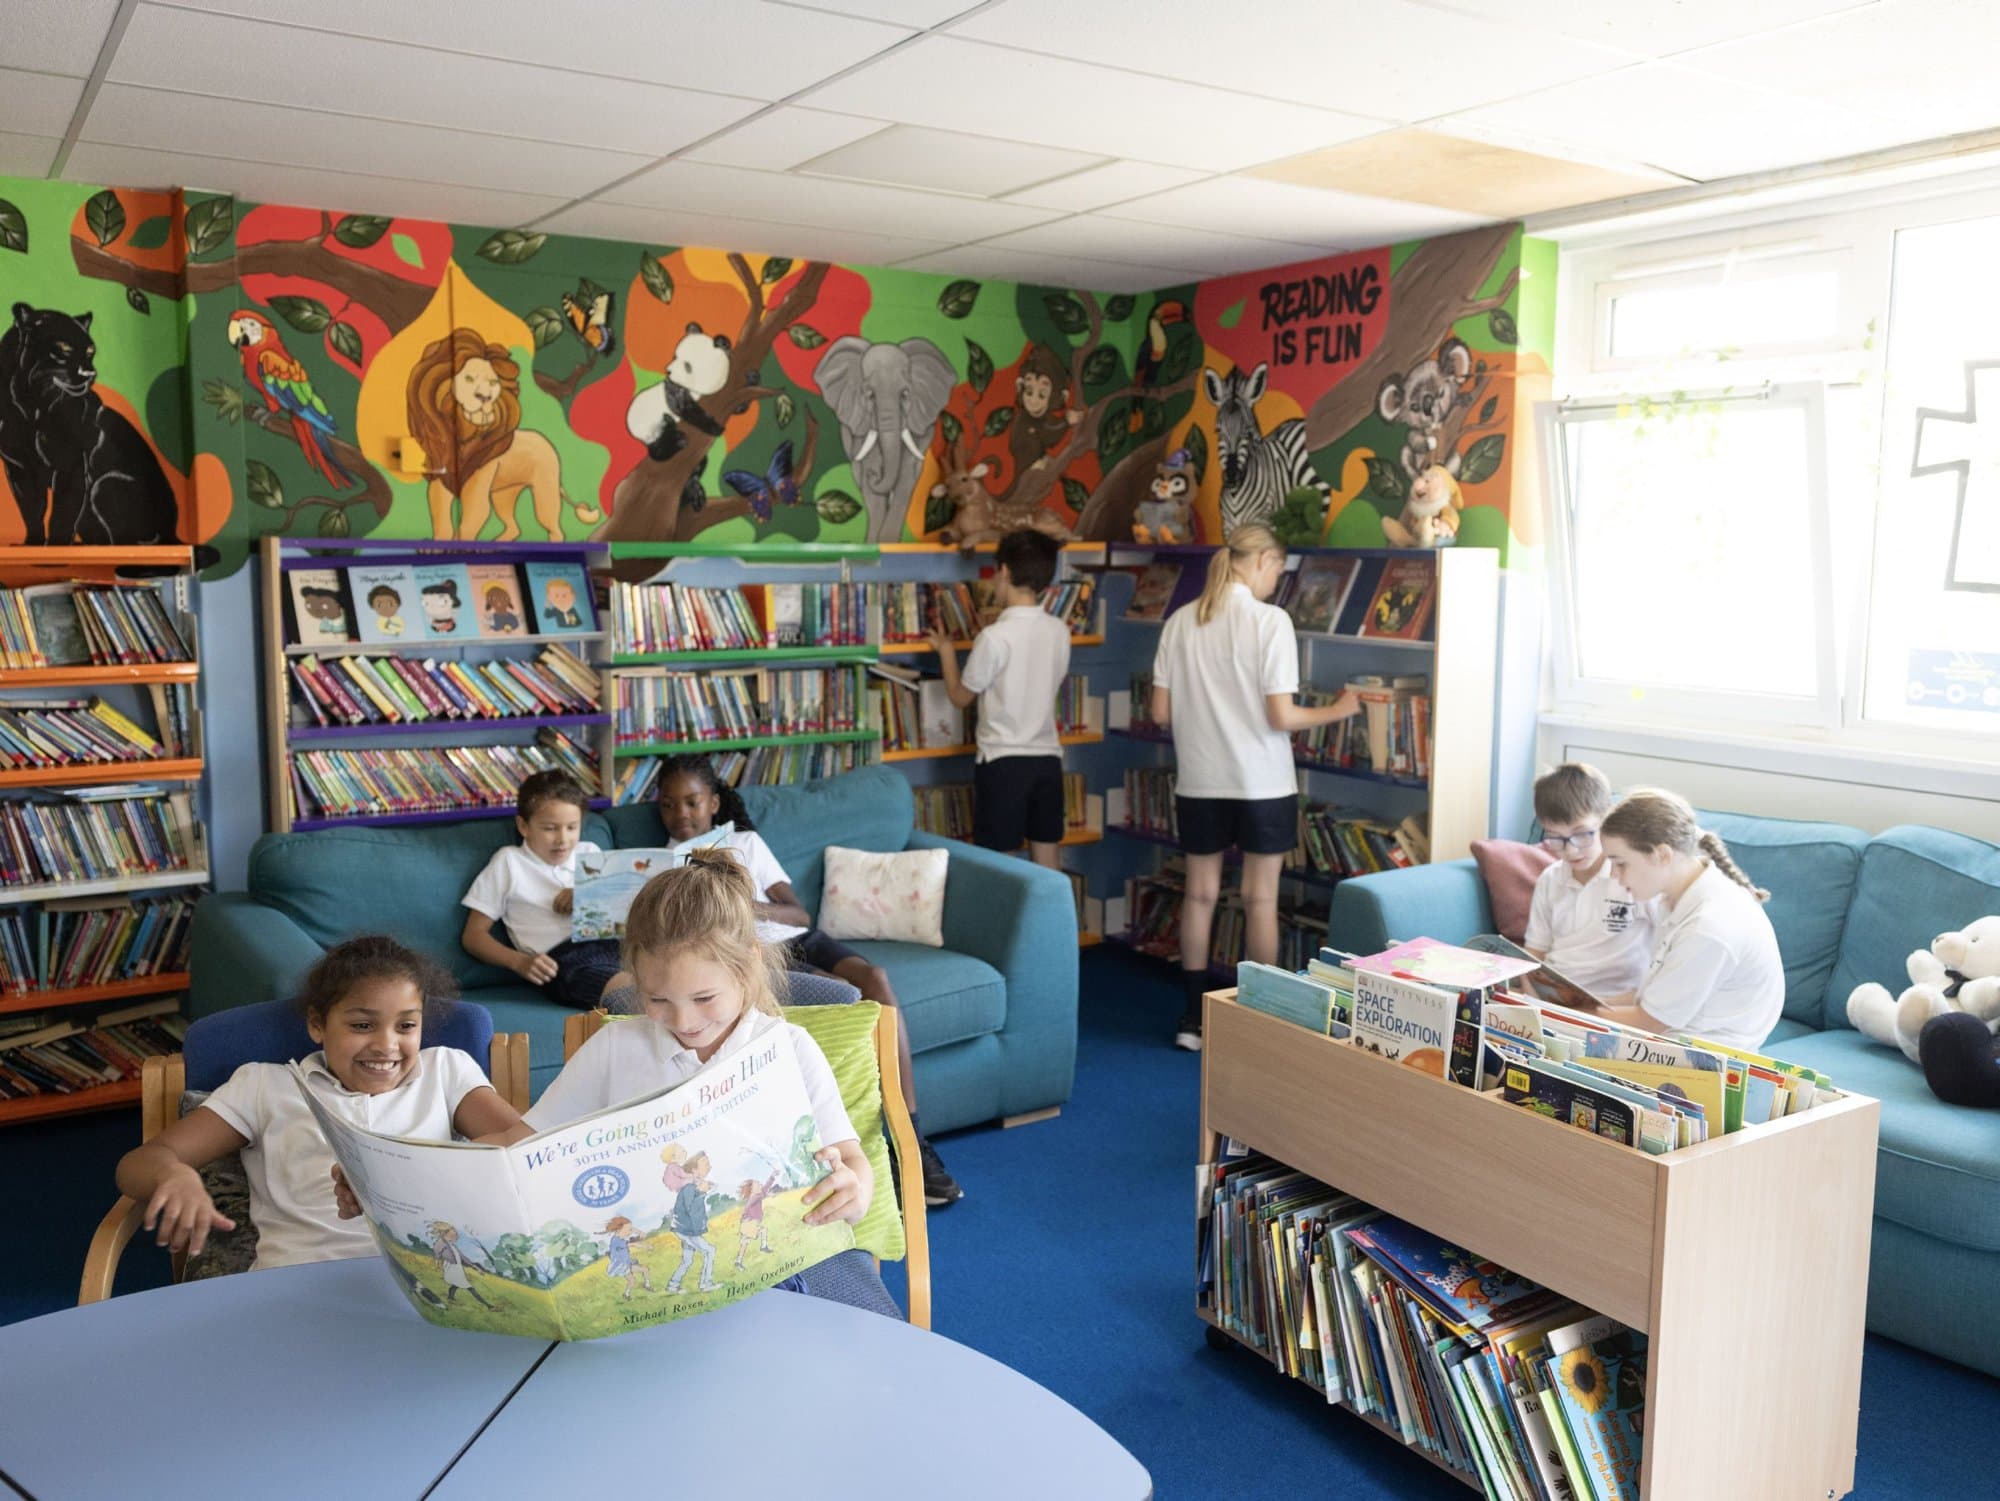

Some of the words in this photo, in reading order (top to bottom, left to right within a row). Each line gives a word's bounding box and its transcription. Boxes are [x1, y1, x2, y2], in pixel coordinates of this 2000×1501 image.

[1260, 263, 1382, 331] READING
[1273, 330, 1298, 366] IS
[1304, 322, 1363, 366] FUN
[1357, 989, 1395, 1014] SPACE
[1356, 1005, 1442, 1047] EXPLORATION
[1626, 1040, 1676, 1066] Down
[525, 1142, 577, 1171] We're
[586, 1121, 649, 1148] Going
[653, 1111, 675, 1130] on
[681, 1103, 692, 1117] a
[698, 1073, 736, 1105] Bear
[740, 1043, 778, 1081] Hunt
[615, 1114, 709, 1156] ANNIVERSARY
[726, 1280, 756, 1299] Helen
[760, 1255, 805, 1282] Oxenbury
[623, 1307, 667, 1325] Michael
[672, 1300, 704, 1314] Rosen
